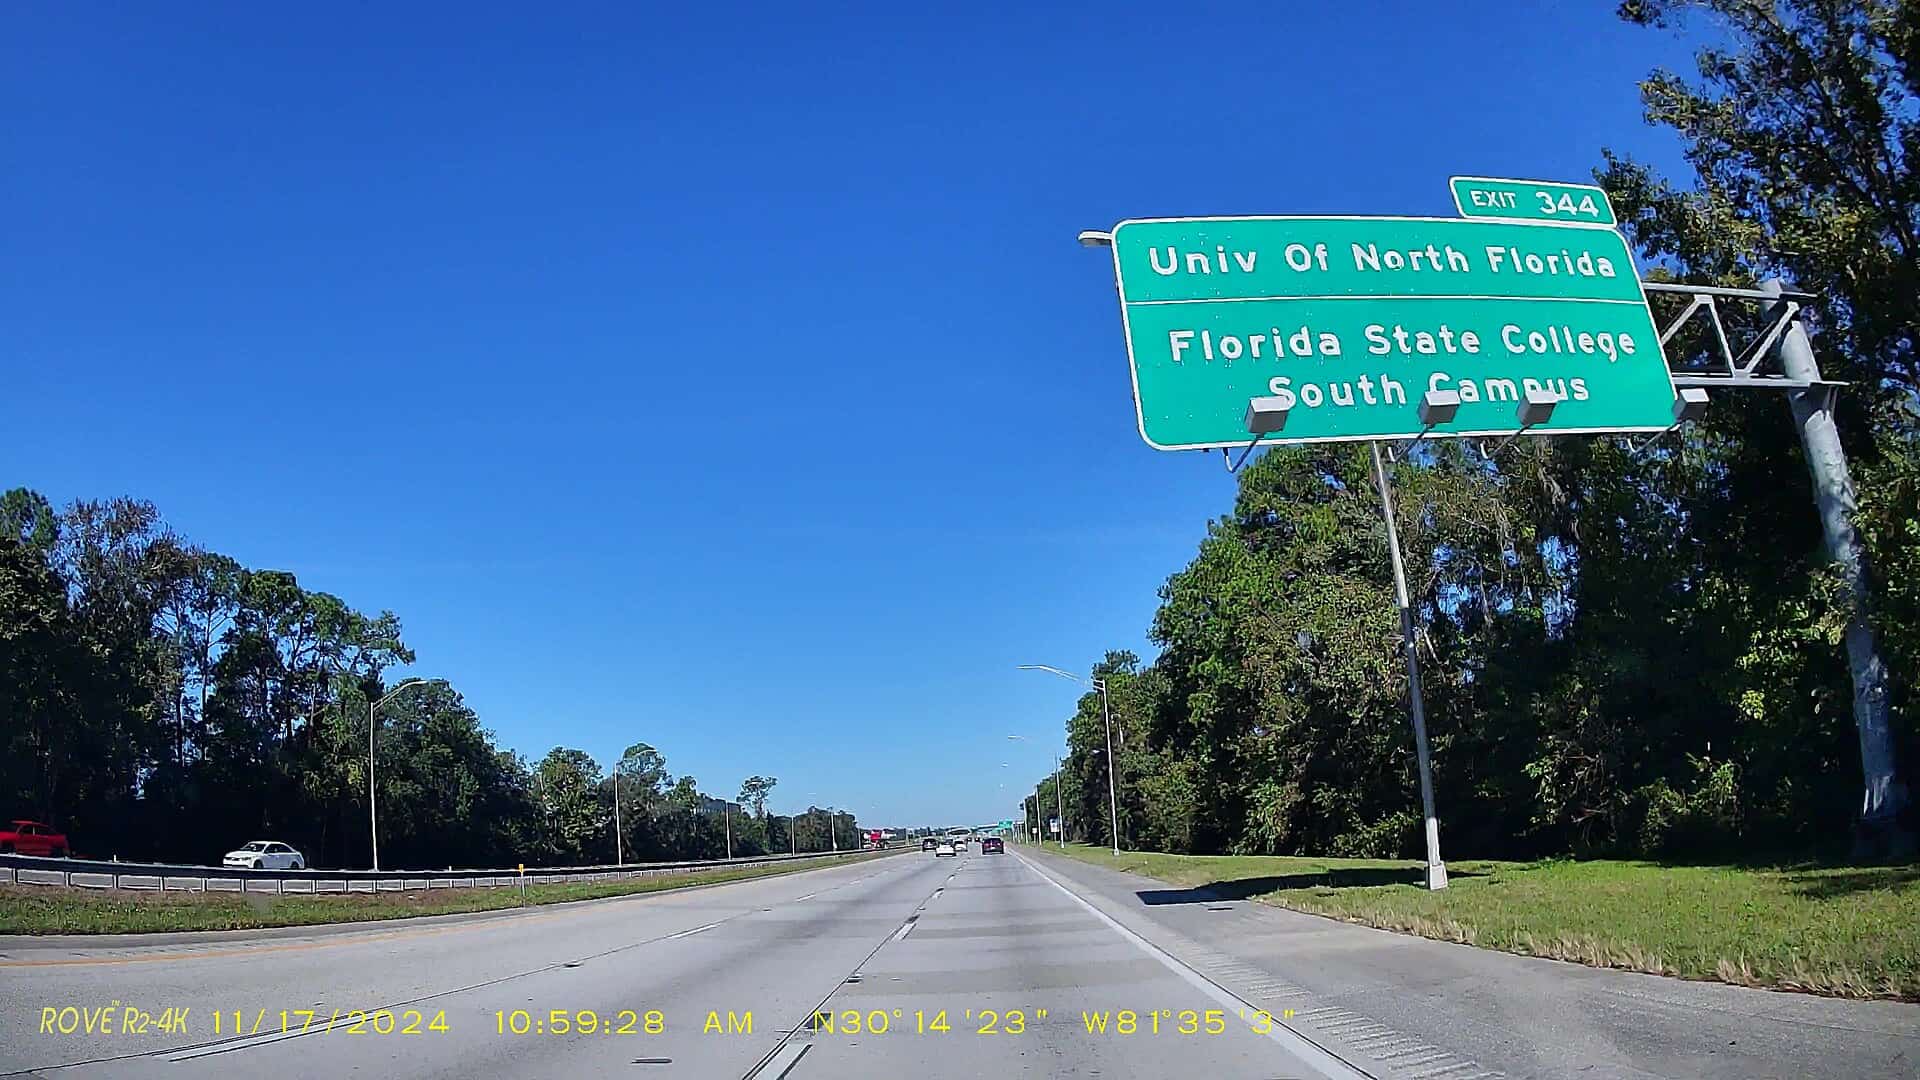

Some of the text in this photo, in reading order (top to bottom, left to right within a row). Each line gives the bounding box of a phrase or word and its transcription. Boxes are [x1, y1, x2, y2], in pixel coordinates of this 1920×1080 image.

[1470, 190, 1599, 217] EXIT 344
[1149, 243, 1616, 279] Univ Of North Florida
[1168, 324, 1637, 364] Florida State College
[1268, 373, 1407, 408] South
